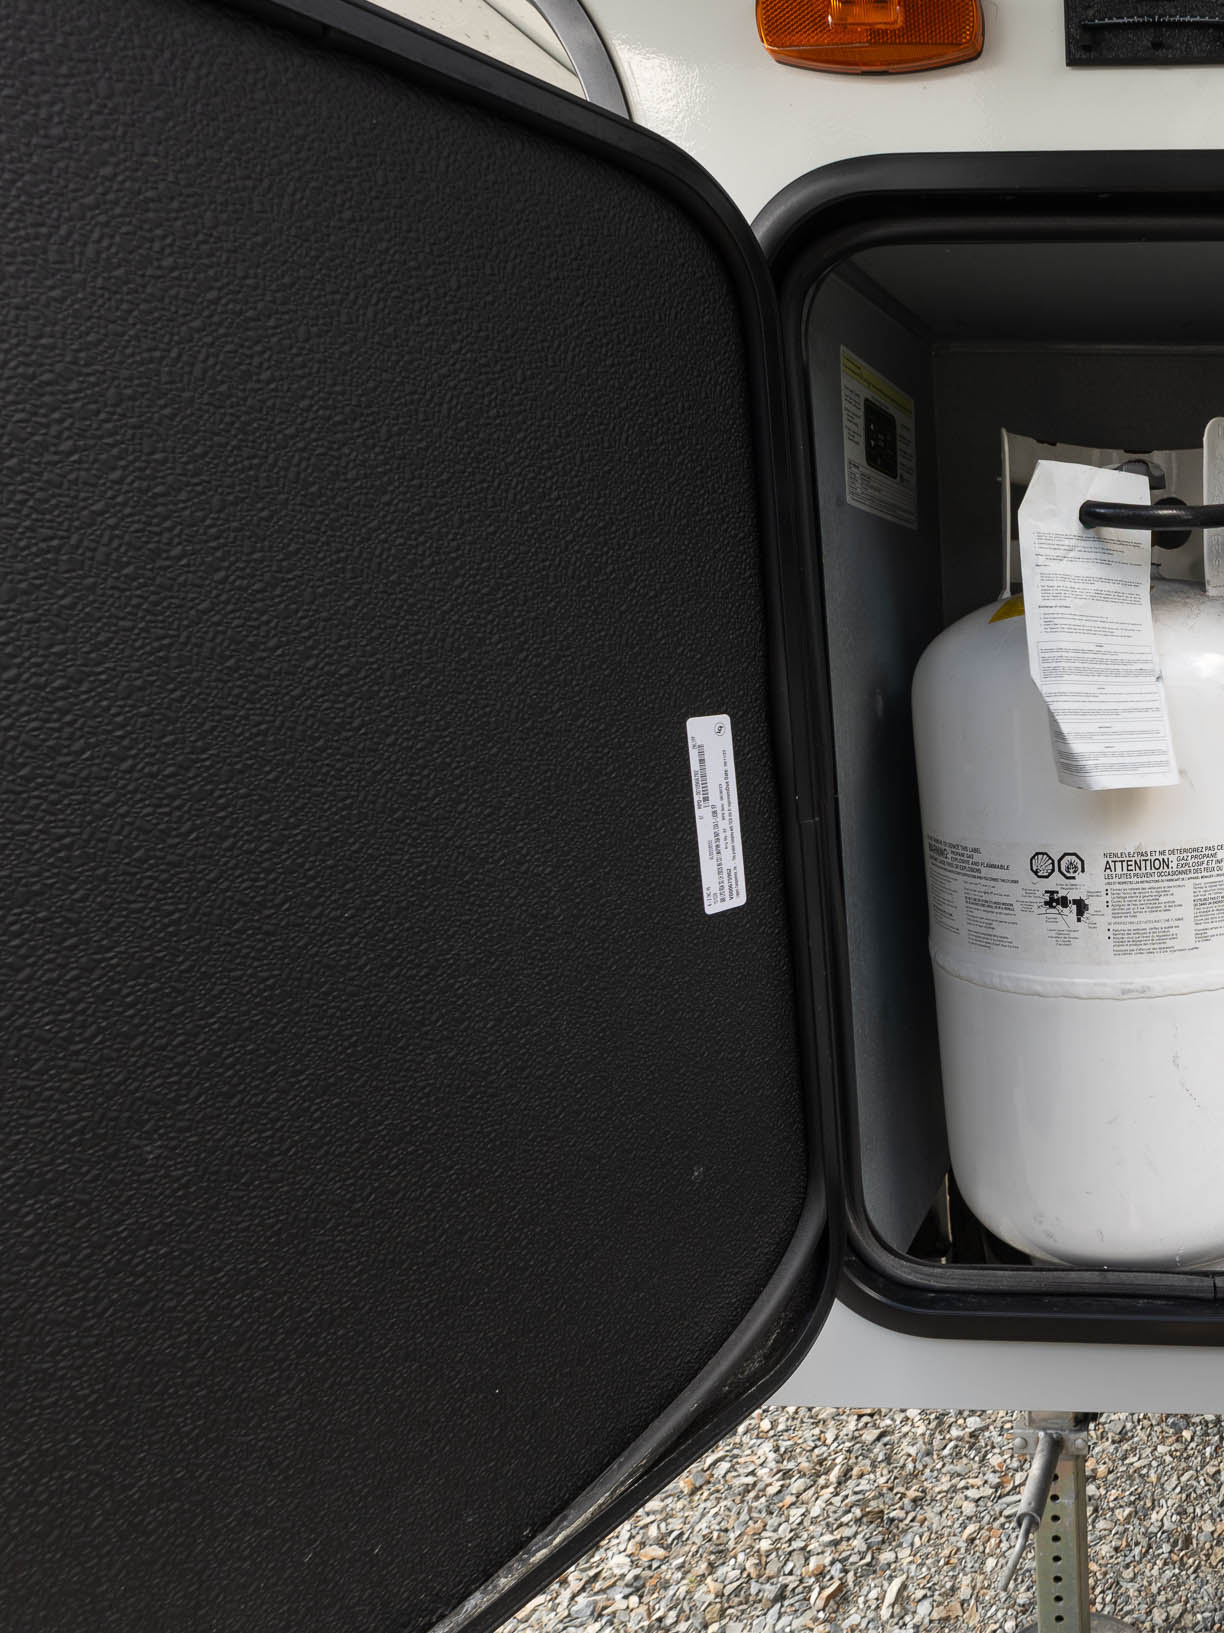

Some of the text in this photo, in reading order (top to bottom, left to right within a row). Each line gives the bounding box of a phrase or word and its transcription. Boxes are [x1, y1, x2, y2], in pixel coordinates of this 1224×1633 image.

[1103, 852, 1136, 860] N'ENLEVEZ
[1190, 852, 1218, 861] PROPANE
[1103, 857, 1174, 873] ATTENTION:
[1176, 860, 1205, 869] EXPLOSIF
[1156, 869, 1192, 878] OCCASIONNER
[1192, 867, 1202, 875] DES
[1203, 866, 1215, 874] FEUX
